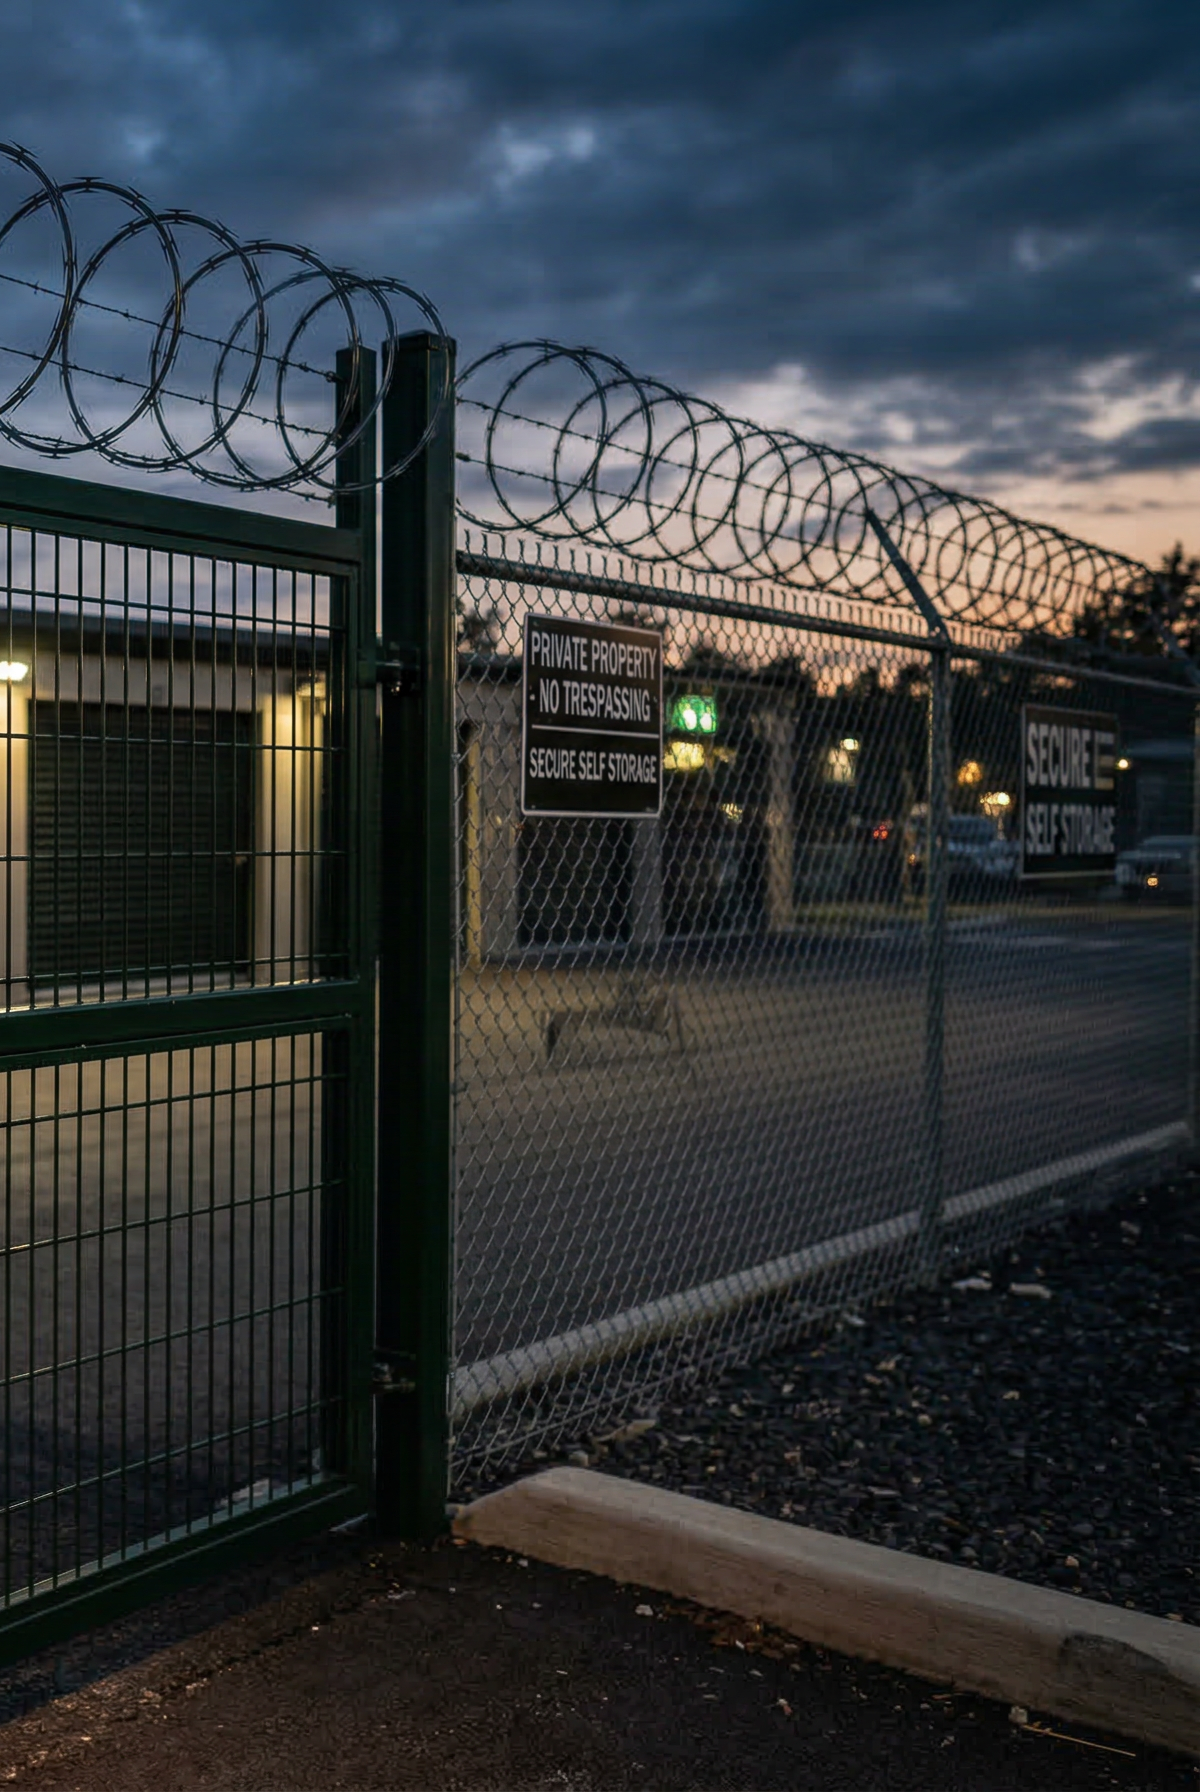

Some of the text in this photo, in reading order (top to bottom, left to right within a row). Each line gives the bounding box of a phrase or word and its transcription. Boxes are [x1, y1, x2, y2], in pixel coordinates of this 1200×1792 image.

[531, 630, 658, 680] PRIVATE PROPERTY
[539, 678, 651, 722] NO TRESPASSING
[529, 747, 658, 784] SECURE SELF STORAGE
[1027, 721, 1091, 788] SECURE
[1026, 802, 1059, 855] SELF
